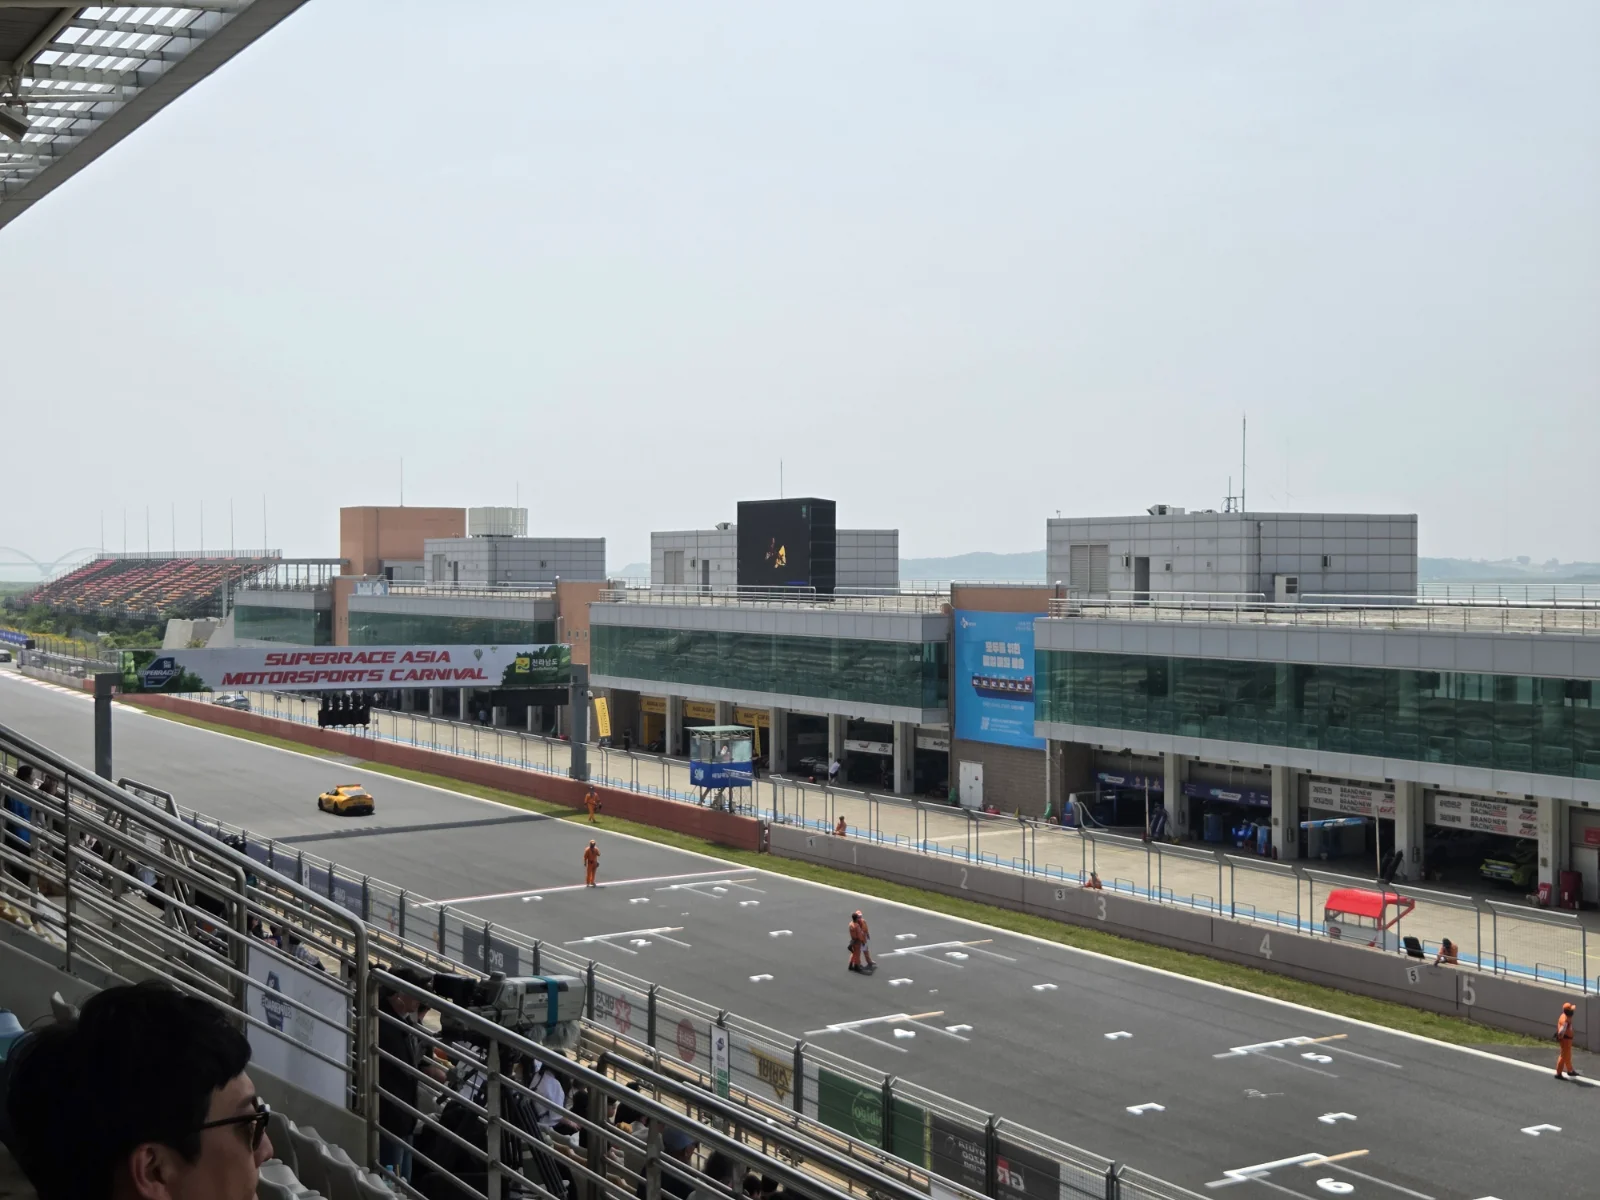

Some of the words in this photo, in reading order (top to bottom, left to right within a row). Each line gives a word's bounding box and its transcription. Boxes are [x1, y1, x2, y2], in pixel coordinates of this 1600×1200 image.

[264, 652, 396, 666] SUPERRACE
[399, 650, 451, 663] ASIA
[222, 669, 385, 685] MOTORSPORTS
[389, 667, 489, 681] CARNIVAL
[1471, 800, 1493, 810] BRAND
[1493, 804, 1507, 812] NEW
[852, 845, 858, 865] 1
[960, 867, 969, 890] 2
[1056, 888, 1064, 899] 3
[1096, 896, 1107, 921] 3
[1259, 932, 1273, 960] 4
[1409, 970, 1418, 982] 5
[1461, 975, 1476, 1005] 5
[1300, 1052, 1333, 1064] 5
[1316, 1177, 1354, 1194] 6
